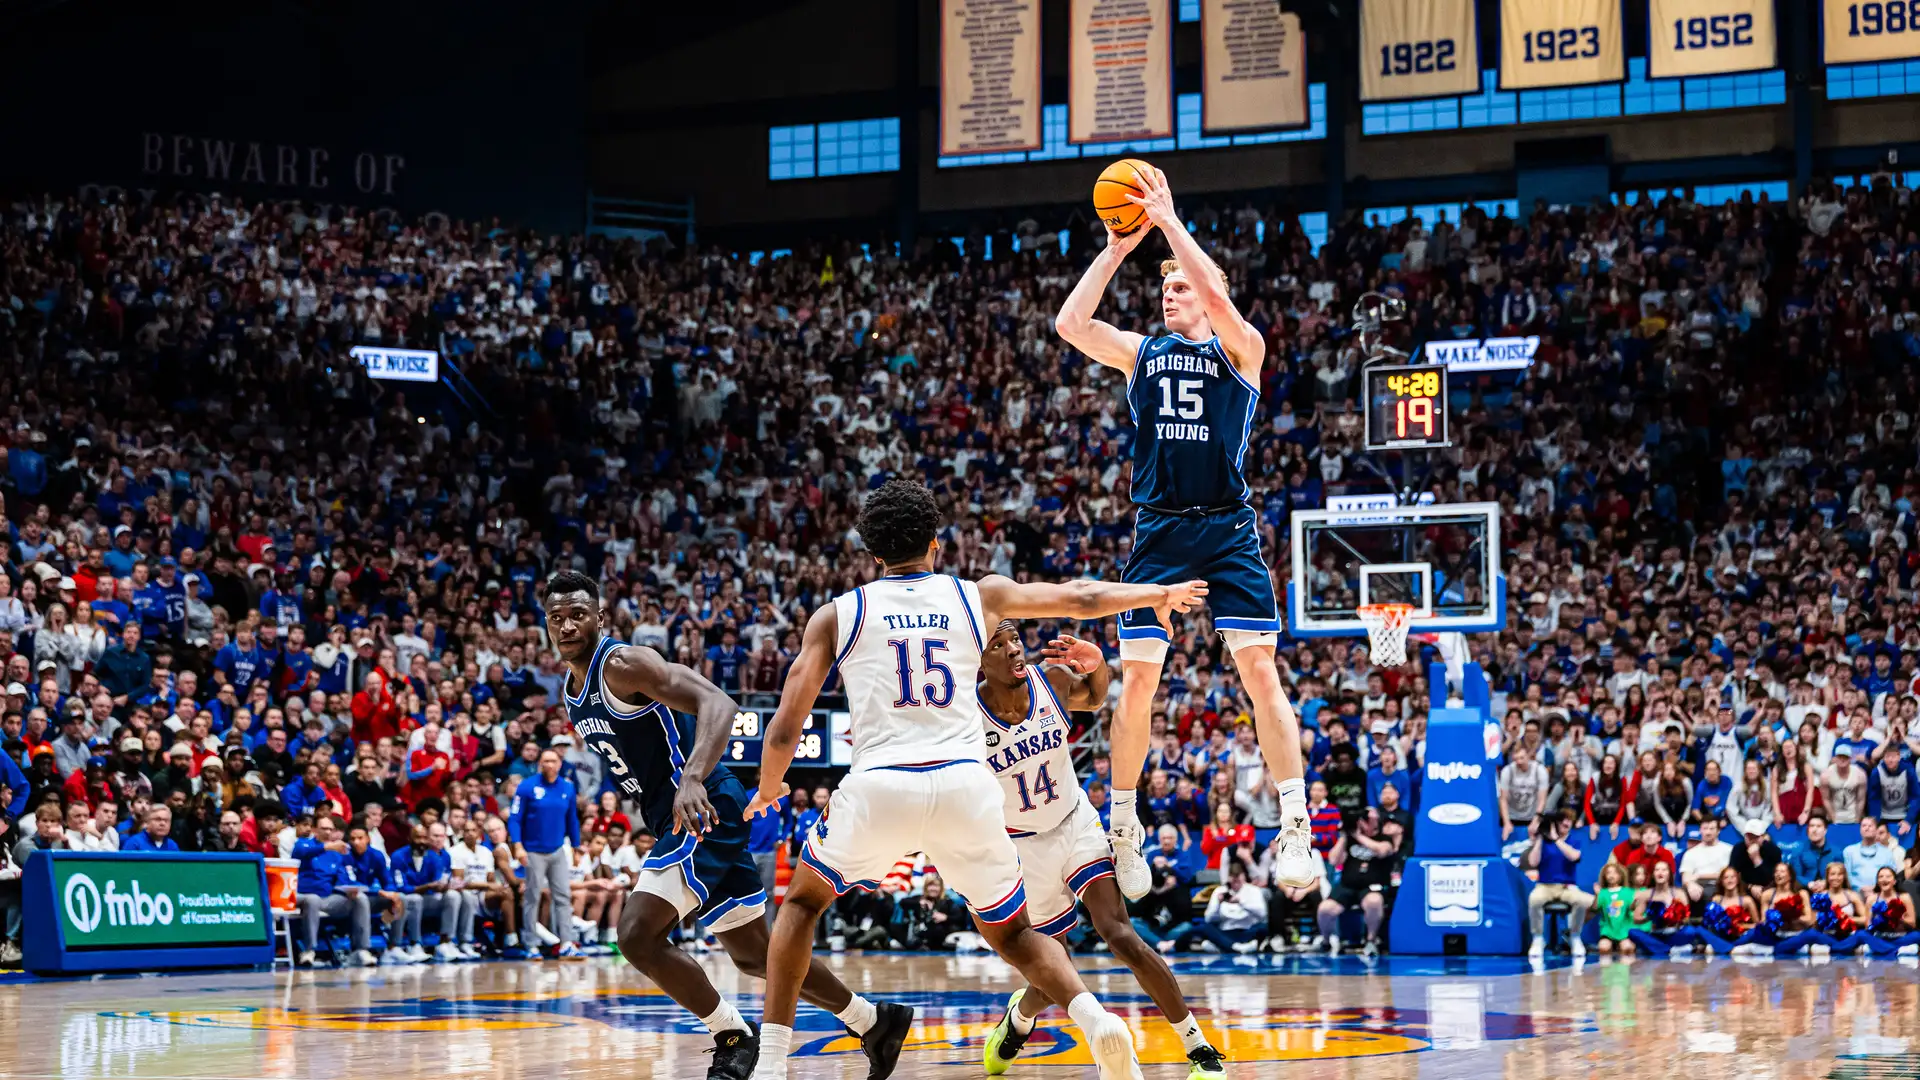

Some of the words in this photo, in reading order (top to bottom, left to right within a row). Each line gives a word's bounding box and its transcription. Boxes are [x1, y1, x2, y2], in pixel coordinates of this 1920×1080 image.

[1674, 13, 1753, 50] 1952
[1848, 0, 1920, 36] 1988
[1380, 39, 1456, 76] 1922
[1523, 27, 1600, 62] 1923
[142, 131, 329, 188] BEWARE
[355, 151, 405, 194] OF
[387, 355, 429, 373] NOISE
[1146, 354, 1219, 378] BRIGHAM
[1436, 345, 1481, 364] MAKE
[1486, 343, 1532, 361] NOISE
[1159, 377, 1204, 420] 15
[1387, 371, 1439, 397] 4:28
[1156, 423, 1209, 441] YOUNG
[1396, 397, 1434, 438] 19
[883, 613, 950, 630] TILLER
[887, 638, 957, 708] 15
[731, 711, 759, 737] 28
[986, 733, 998, 745] SW
[986, 728, 1062, 773] KANSAS
[1012, 760, 1060, 812] 14
[103, 879, 174, 926] fnbo
[178, 893, 203, 907] Proud
[203, 893, 224, 907] Bank
[224, 893, 254, 907] Partner
[181, 911, 191, 924] of
[191, 911, 221, 924] Kansas
[221, 910, 255, 924] Athletics
